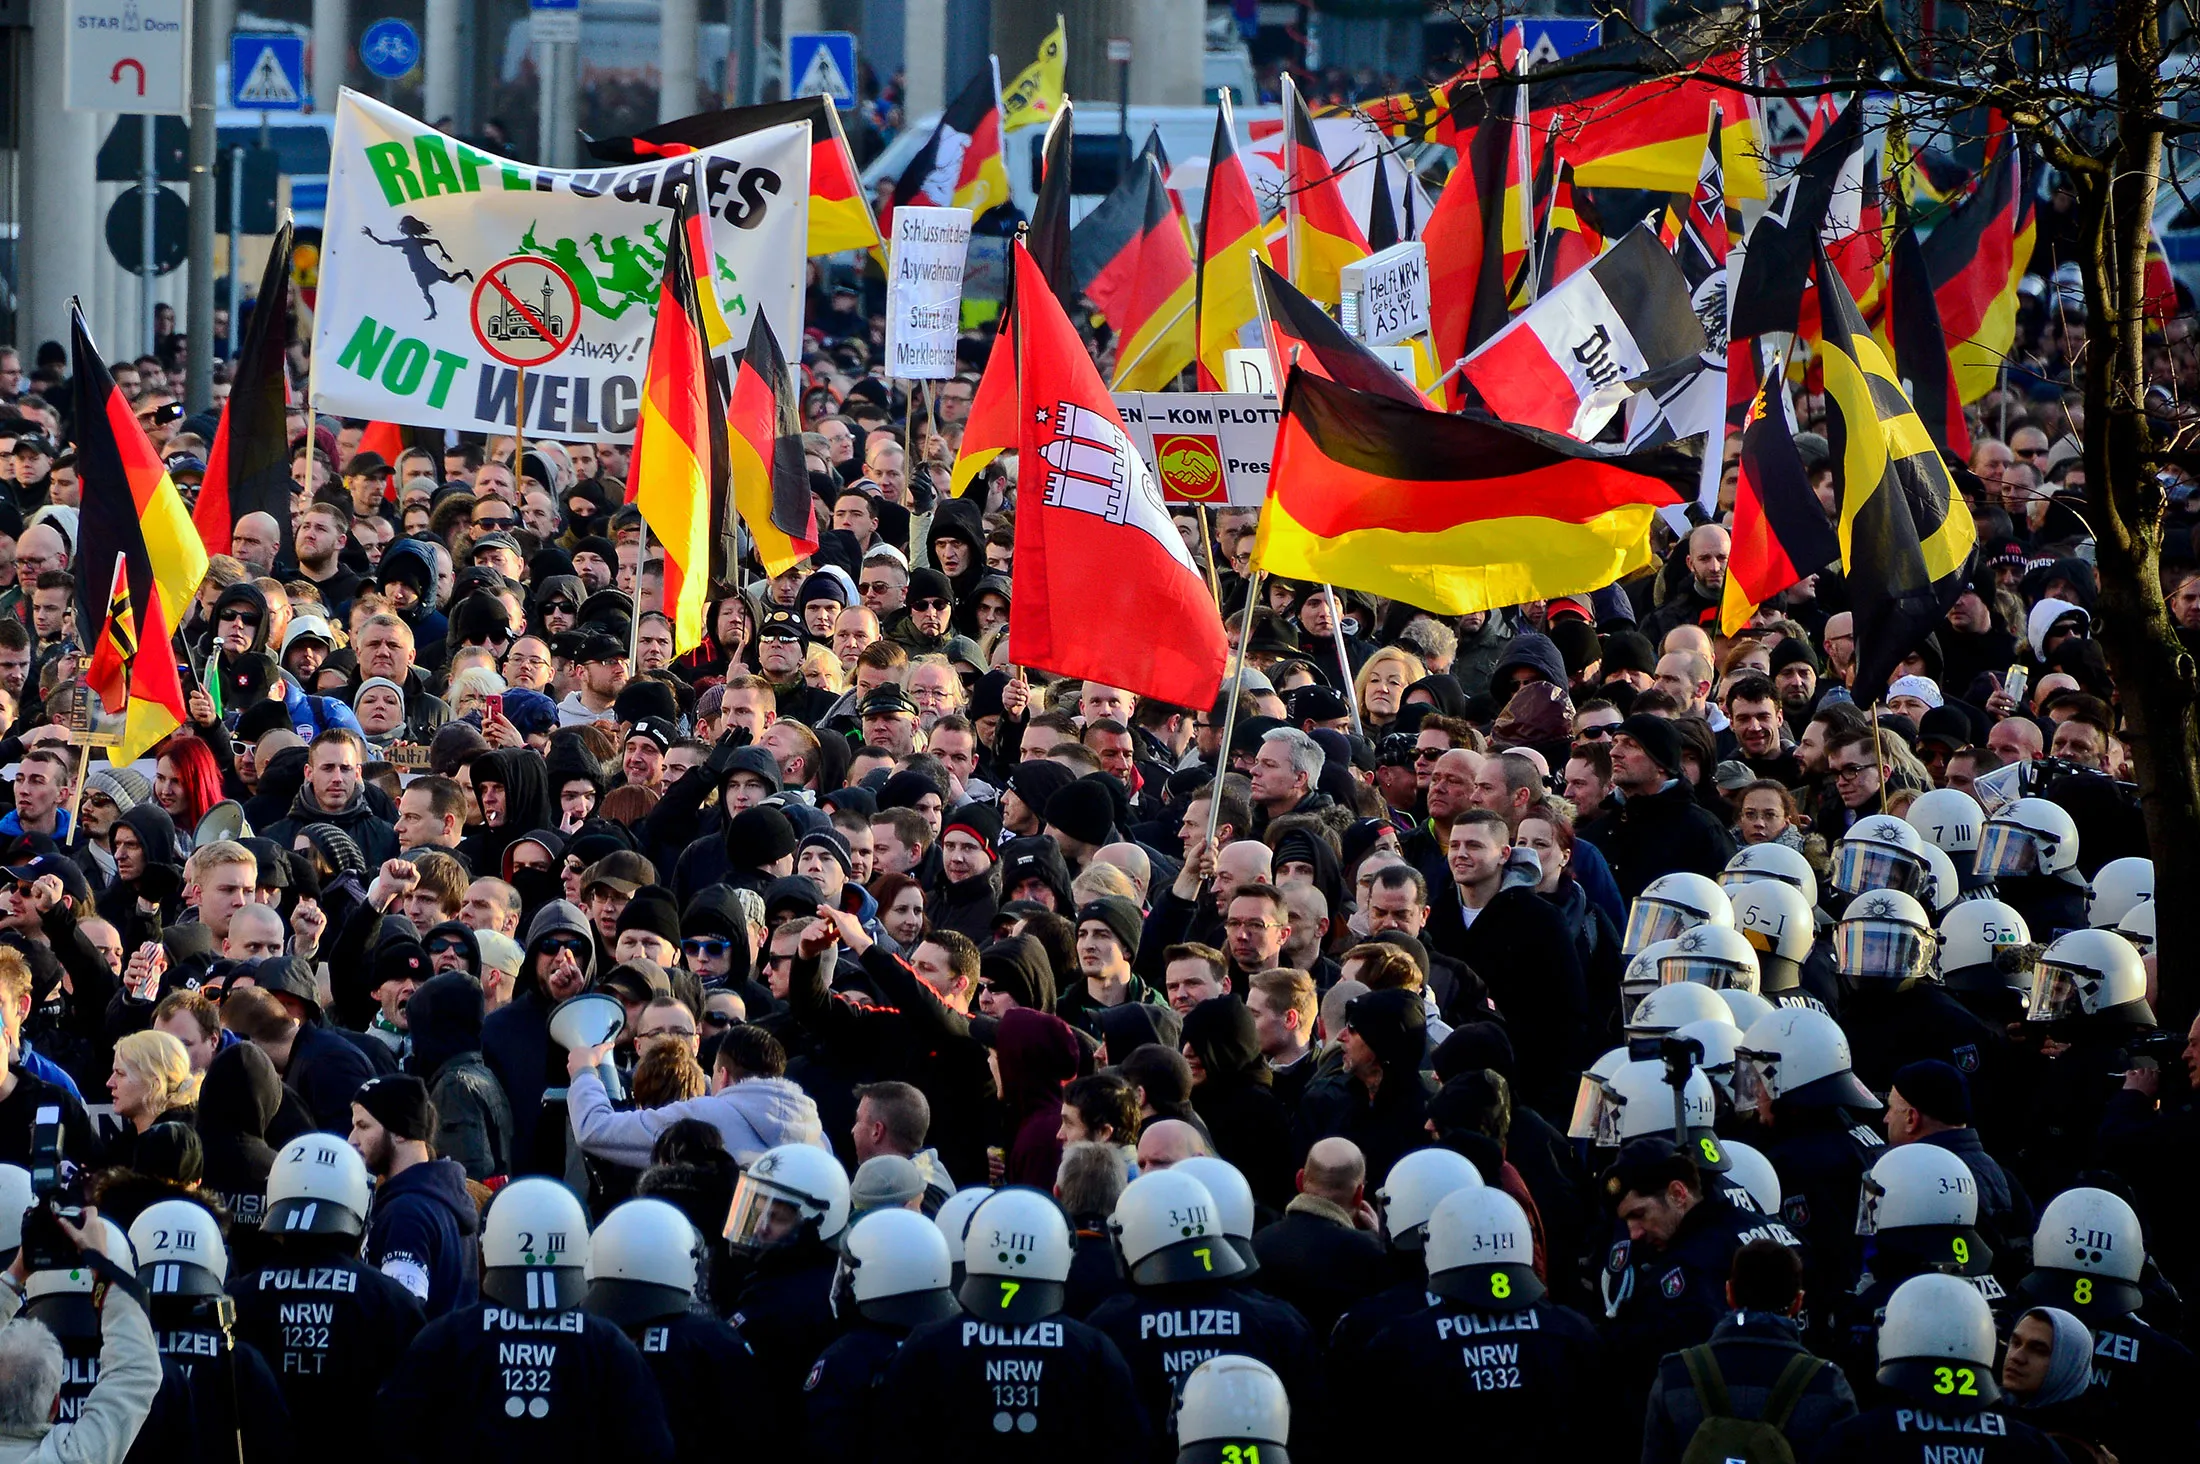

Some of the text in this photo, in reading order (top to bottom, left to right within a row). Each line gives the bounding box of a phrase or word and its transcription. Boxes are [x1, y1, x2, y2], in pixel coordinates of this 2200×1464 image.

[78, 15, 179, 31] STAR Dom
[902, 218, 940, 243] Schluss
[1369, 270, 1397, 302] Helft
[1375, 300, 1419, 338] ASYL
[337, 315, 468, 410] NOT
[1932, 825, 1944, 843] 7
[289, 1145, 306, 1163] 2
[1700, 1138, 1721, 1164] 8
[1169, 1205, 1209, 1228] 3-III
[153, 1229, 170, 1251] 2
[518, 1231, 534, 1253] 2
[990, 1230, 1036, 1252] 3-III
[1952, 1237, 1969, 1264] 9
[1193, 1247, 1214, 1272] 7
[258, 1267, 358, 1293] POLIZEI
[1490, 1272, 1511, 1299] 8
[2073, 1277, 2093, 1305] 8
[1000, 1281, 1020, 1309] 7
[279, 1303, 334, 1324] NRW
[483, 1308, 584, 1334] POLIZEI
[1140, 1309, 1241, 1340] POLIZEI
[1436, 1308, 1540, 1340] POLIZEI
[281, 1326, 329, 1349] 1232
[962, 1321, 1064, 1347] POLIZEI
[283, 1352, 327, 1375] FLT
[499, 1342, 556, 1367] NRW
[1163, 1348, 1221, 1373] NRW
[1463, 1343, 1519, 1368] NRW
[501, 1368, 552, 1393] 1232
[986, 1360, 1043, 1381] NRW
[1470, 1367, 1522, 1392] 1332
[1933, 1367, 1979, 1396] 32
[992, 1384, 1039, 1407] 1331
[1896, 1408, 2007, 1436] POLIZEI
[1221, 1444, 1261, 1464] 31
[1923, 1445, 1985, 1464] NRW
